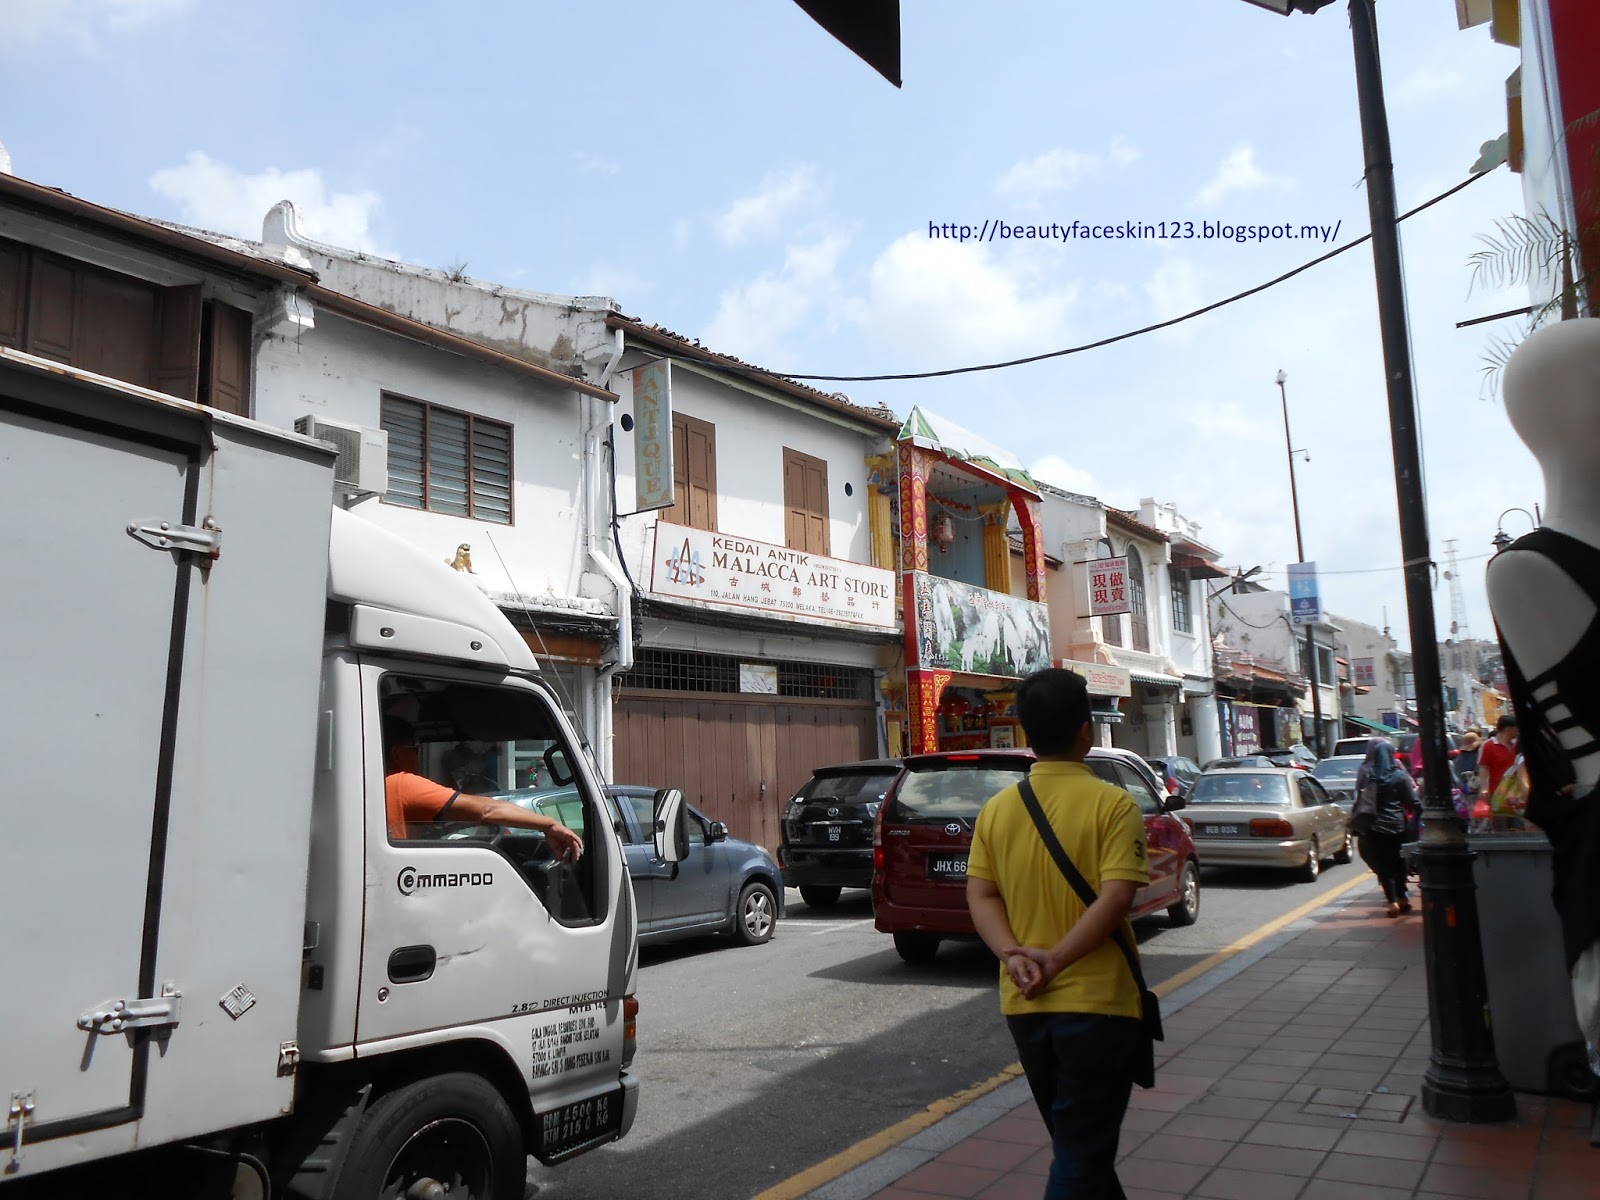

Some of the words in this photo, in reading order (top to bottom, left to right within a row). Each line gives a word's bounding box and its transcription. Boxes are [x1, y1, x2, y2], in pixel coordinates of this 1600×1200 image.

[642, 377, 661, 494] ANTIQUE
[712, 536, 759, 556] KEDAI
[767, 549, 809, 566] ANTIK
[712, 551, 800, 583] MALACCA
[807, 572, 839, 590] ART
[844, 577, 889, 599] STORE
[721, 591, 740, 600] JALAN
[743, 594, 758, 604] HANG
[761, 597, 777, 606] JEBAT
[933, 861, 952, 873] JHX
[543, 996, 570, 1008] DIRECT
[571, 990, 609, 1002] INJECTION
[569, 1004, 592, 1015] MTB
[564, 1101, 592, 1121] 4500
